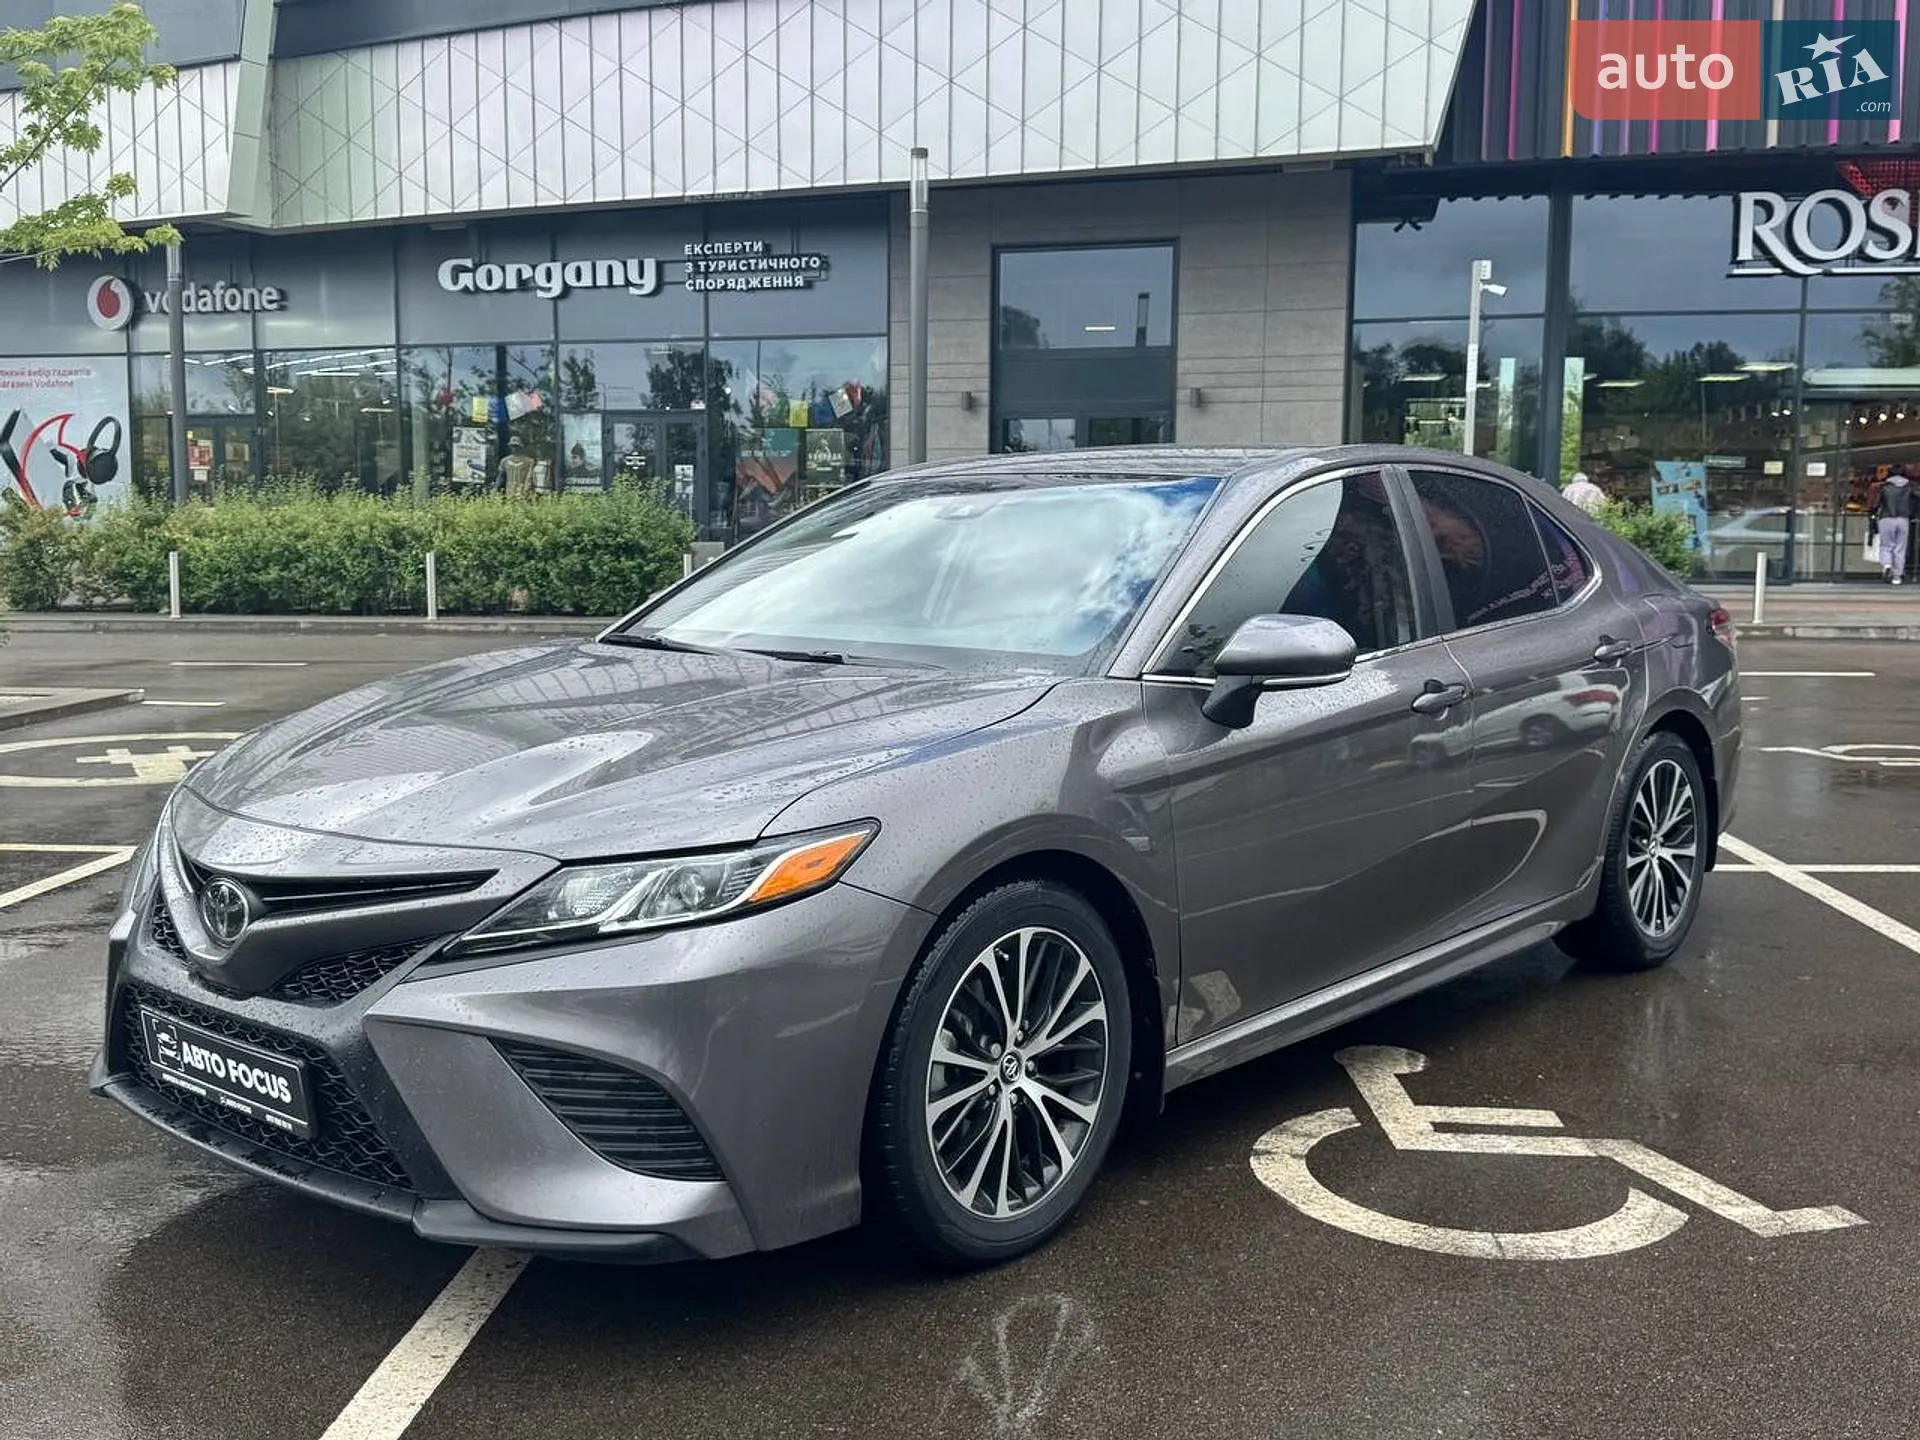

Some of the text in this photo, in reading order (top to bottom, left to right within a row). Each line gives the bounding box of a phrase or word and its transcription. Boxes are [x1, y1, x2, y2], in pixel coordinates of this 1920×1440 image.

[1736, 188, 1920, 275] ROS
[684, 241, 763, 255] ЕКСПЕРТИ
[437, 257, 656, 299] Gorgany
[698, 256, 820, 273] ТУРИСТИЧНОГО
[685, 275, 804, 291] СПОРЯДЖЕННЯ
[182, 1041, 226, 1079] АВТО
[226, 1057, 292, 1104] FOCUS
